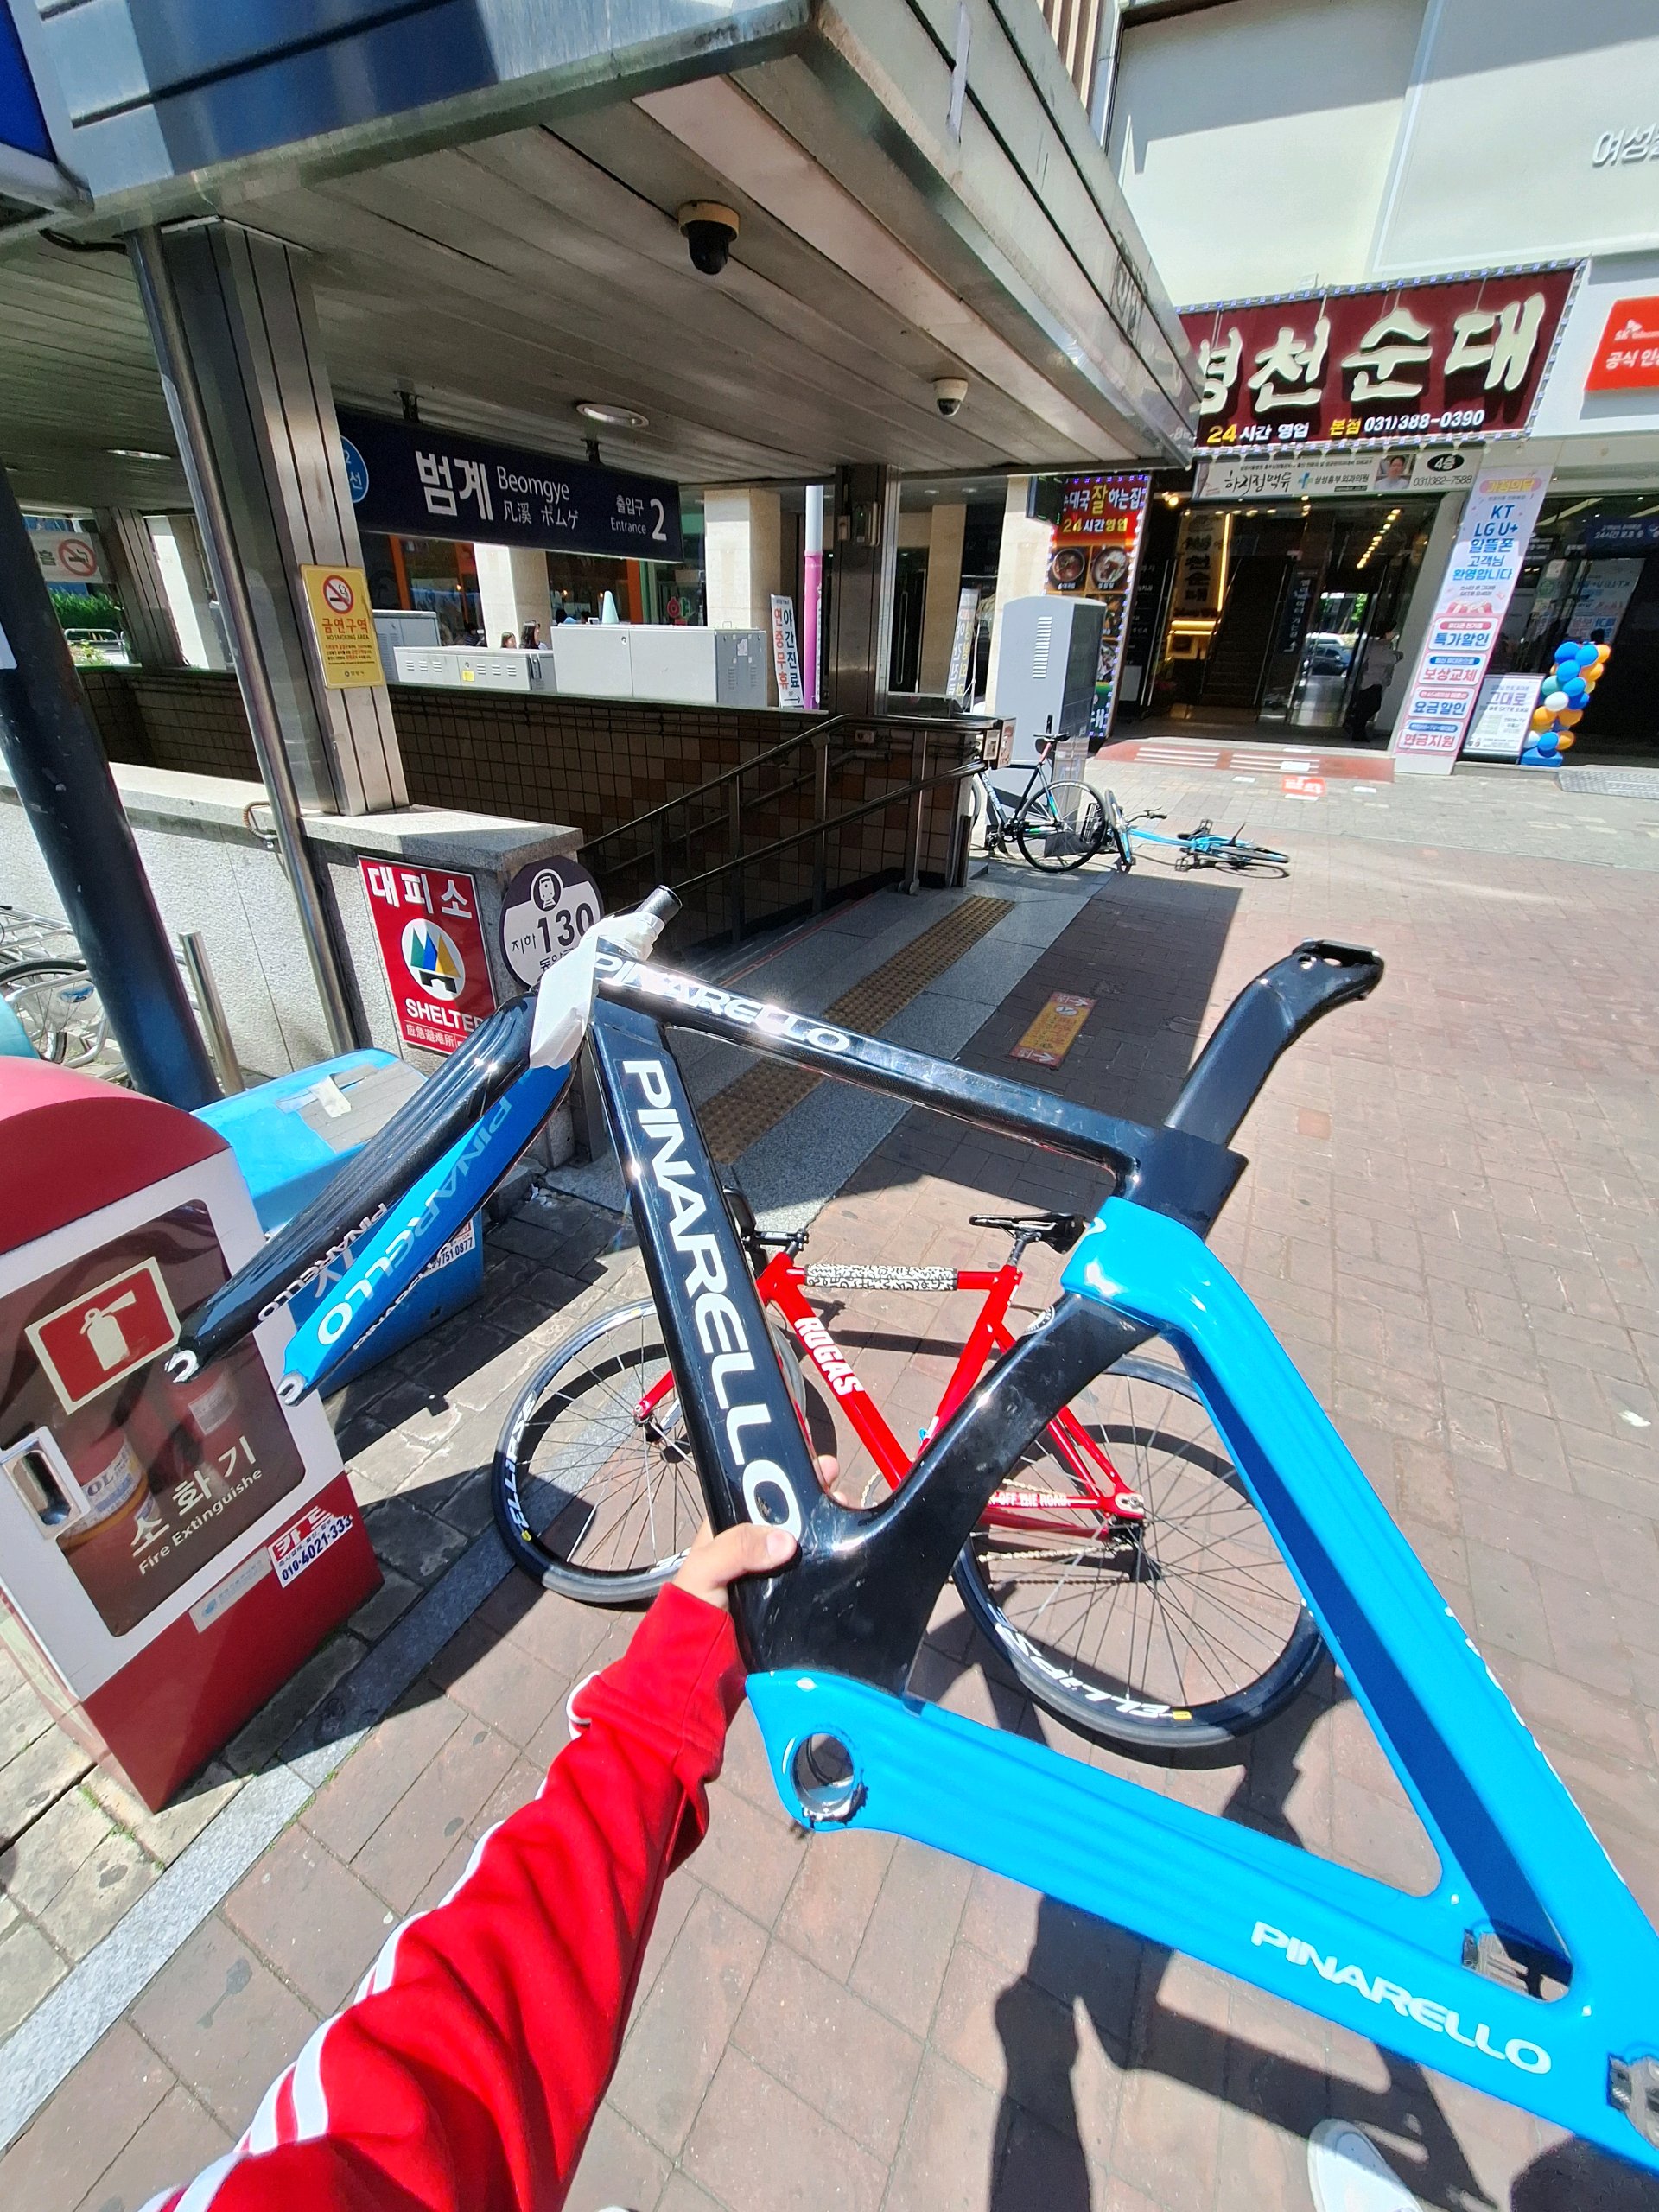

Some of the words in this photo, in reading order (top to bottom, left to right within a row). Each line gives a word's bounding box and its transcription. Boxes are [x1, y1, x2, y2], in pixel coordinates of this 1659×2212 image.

[1605, 349, 1640, 370] 공식
[1640, 347, 1659, 368] 인
[1207, 423, 1272, 445] 24시간
[1278, 422, 1310, 441] 영업
[1329, 418, 1360, 435] 본점
[1363, 409, 1485, 434] 031)388-0390
[1434, 456, 1458, 471] 4층
[416, 450, 494, 520] 범계
[496, 466, 570, 501] Beomgye
[1224, 469, 1293, 498] 하지정맥류
[504, 500, 532, 525] 凡溪
[541, 505, 579, 530] ポムゲ
[615, 495, 645, 518] 출입구
[650, 498, 667, 542] 2
[1491, 505, 1516, 520] KT
[611, 518, 647, 536] Entrance
[1474, 522, 1496, 537] LG
[1498, 521, 1519, 537] U+
[1469, 537, 1515, 554] 알뜰폰
[1452, 569, 1513, 581] 환영합니다
[1467, 555, 1505, 567] 고객님
[322, 618, 369, 634] 금연구역
[1433, 632, 1491, 646] 특가할인
[774, 607, 789, 690] 연중무휴
[783, 609, 800, 688] 야간진료
[1423, 667, 1478, 682] 보상교체
[1413, 701, 1467, 715] 요금할인
[1486, 692, 1527, 705] 그대로
[1403, 734, 1455, 747] 현금지원
[367, 867, 473, 919] 대피소
[512, 933, 537, 955] 지하
[537, 902, 594, 954] 130
[318, 1096, 512, 1345] PINARELLO
[623, 1059, 802, 1541] PINARELLO
[794, 1317, 865, 1396] ROGAS
[130, 1435, 257, 1557] 소화기
[138, 1546, 170, 1575] Fire
[172, 1470, 263, 1548] Extinguishe
[1250, 1920, 1552, 2075] PINARELLO
